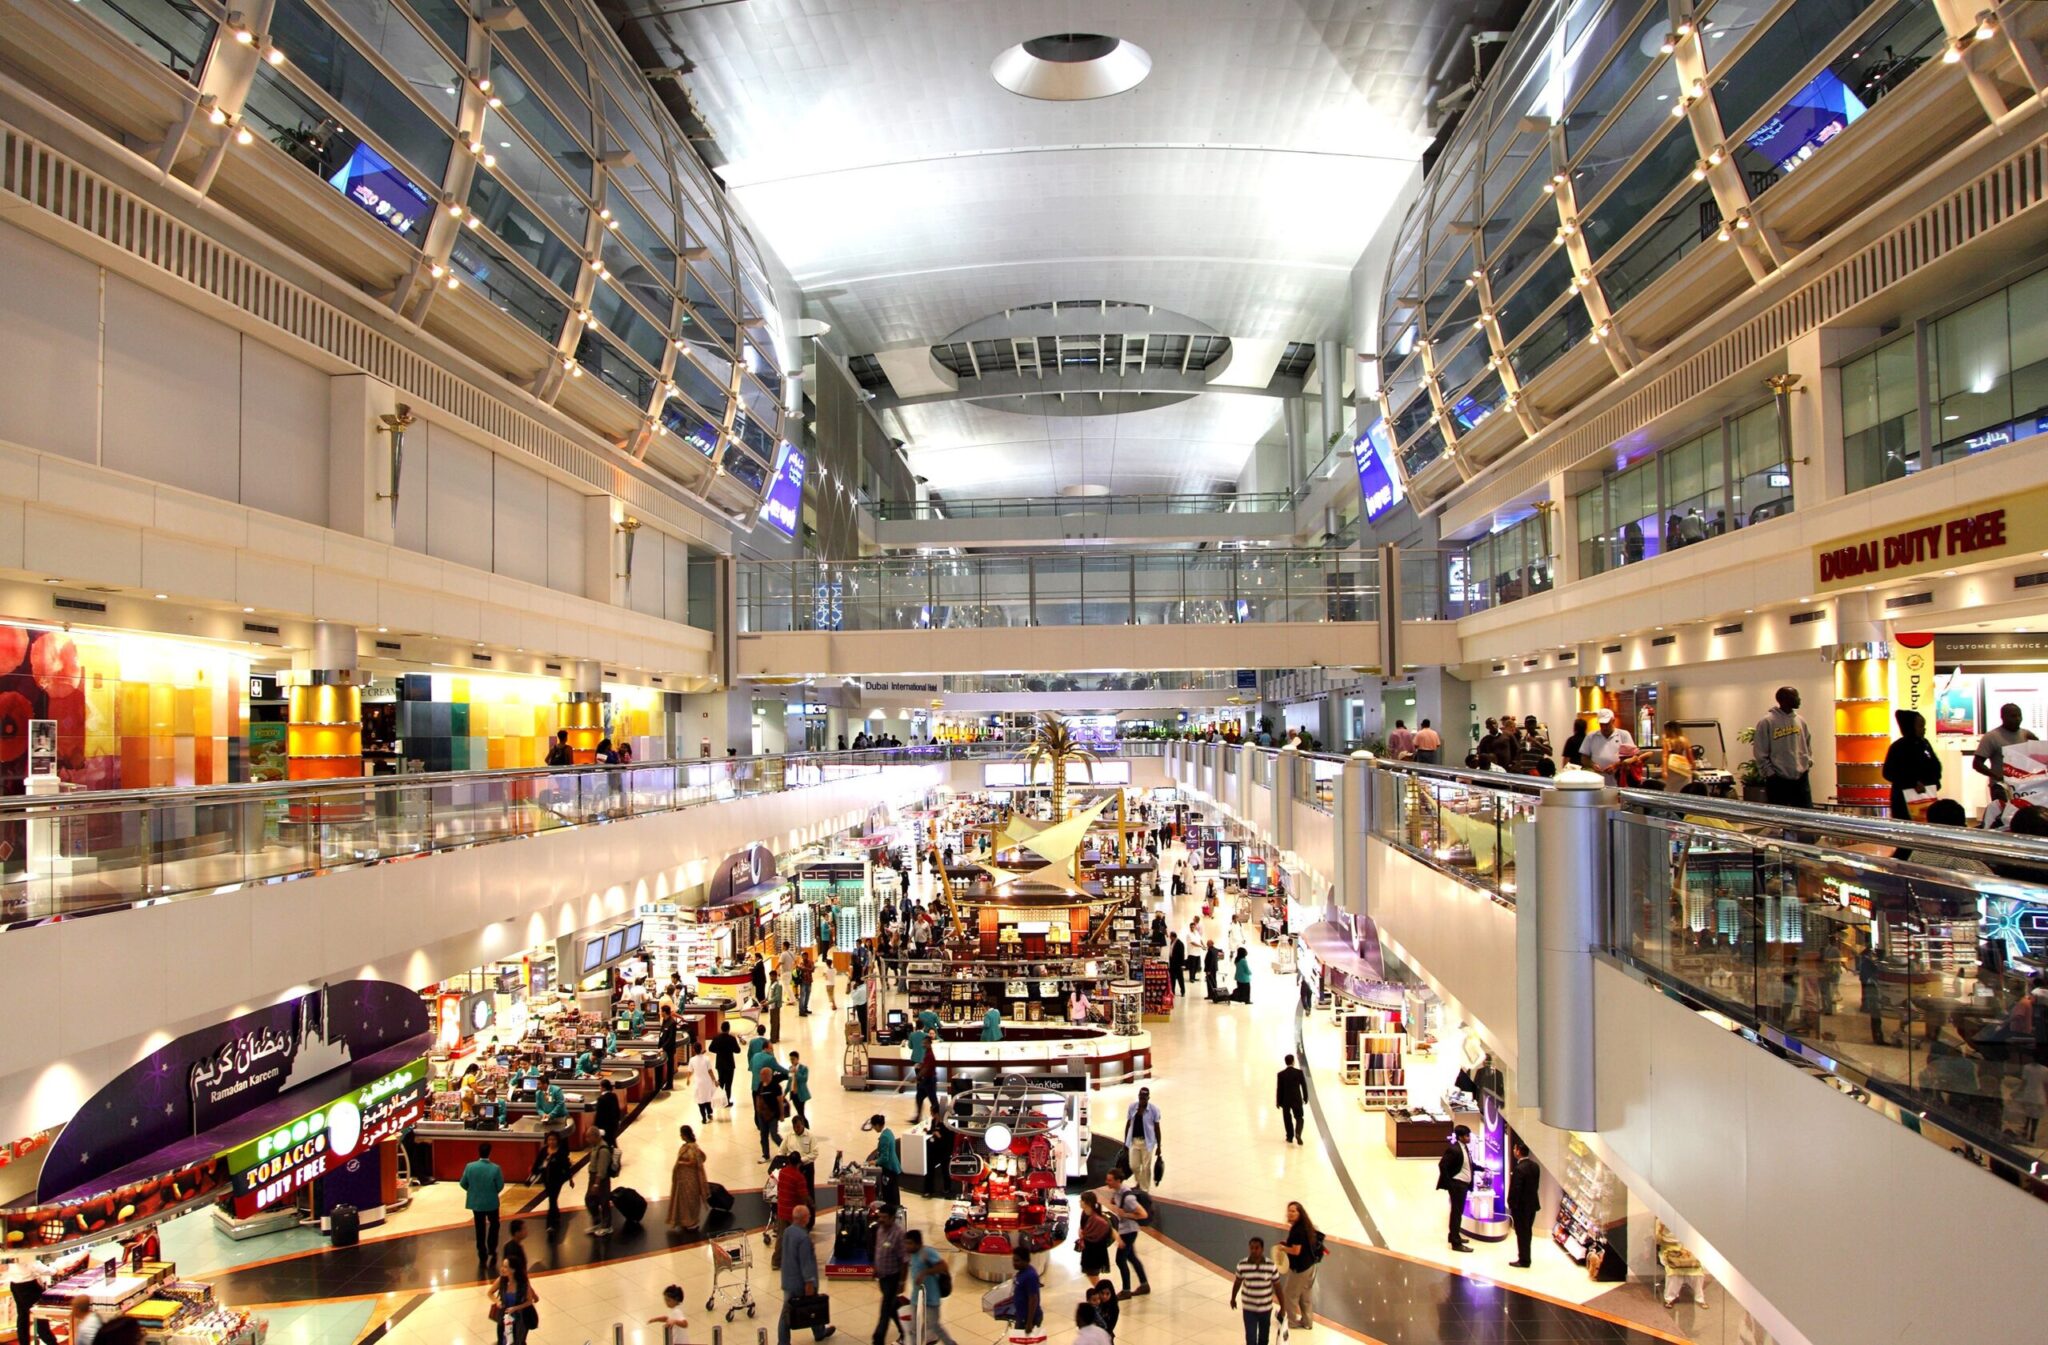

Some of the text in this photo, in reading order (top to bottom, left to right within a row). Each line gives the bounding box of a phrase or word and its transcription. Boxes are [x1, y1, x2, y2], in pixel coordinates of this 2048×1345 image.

[1820, 509, 2007, 582] DUBAI DUTY FREE
[865, 681, 888, 690] Dubai
[891, 682, 926, 691] International
[1910, 674, 1920, 710] Duba
[191, 1028, 292, 1098] رمضان كريم
[210, 1067, 279, 1103] Ramadan Kareem
[1044, 1080, 1063, 1089] Klein
[257, 1112, 326, 1160] FOOD
[246, 1134, 327, 1189] TOBACCO
[257, 1155, 327, 1208] DUTY FREE
